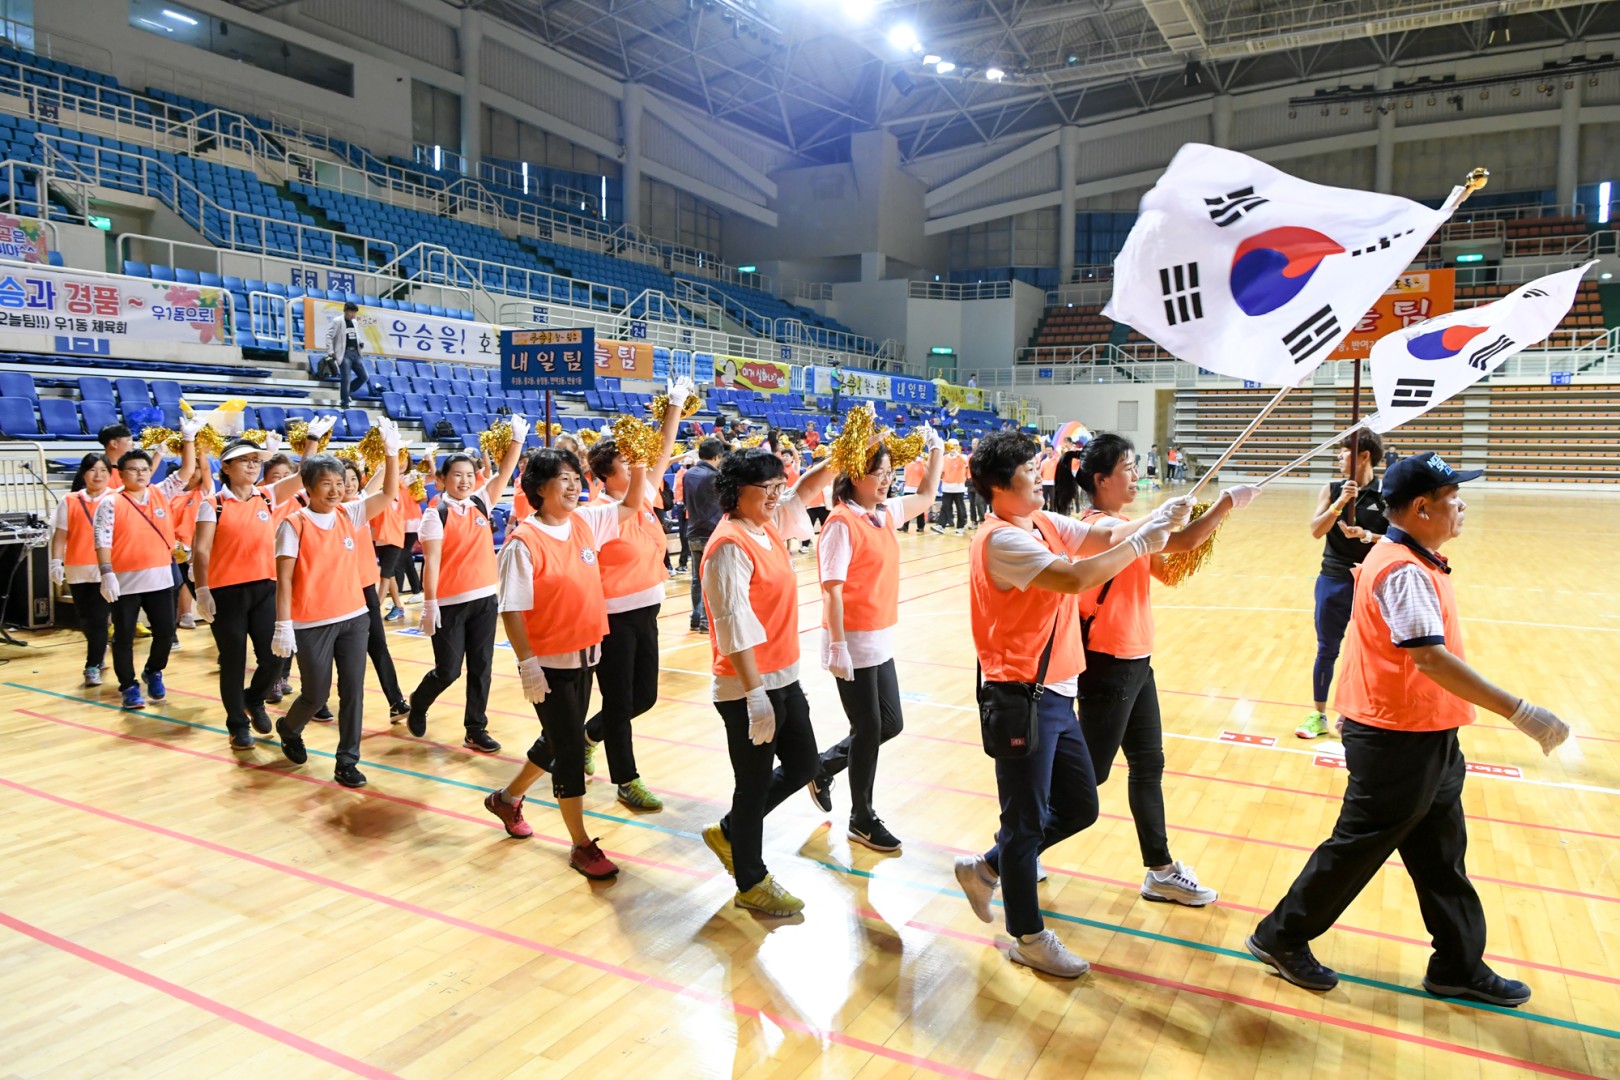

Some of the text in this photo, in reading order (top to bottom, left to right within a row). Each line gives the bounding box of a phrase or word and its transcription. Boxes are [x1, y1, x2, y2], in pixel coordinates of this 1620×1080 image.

[331, 280, 352, 294] 2-3
[64, 282, 120, 316] 경품
[152, 305, 215, 323] 우1동으로!
[55, 317, 88, 332] 우1동
[92, 320, 127, 334] 체육회
[388, 319, 466, 354] 우승을!
